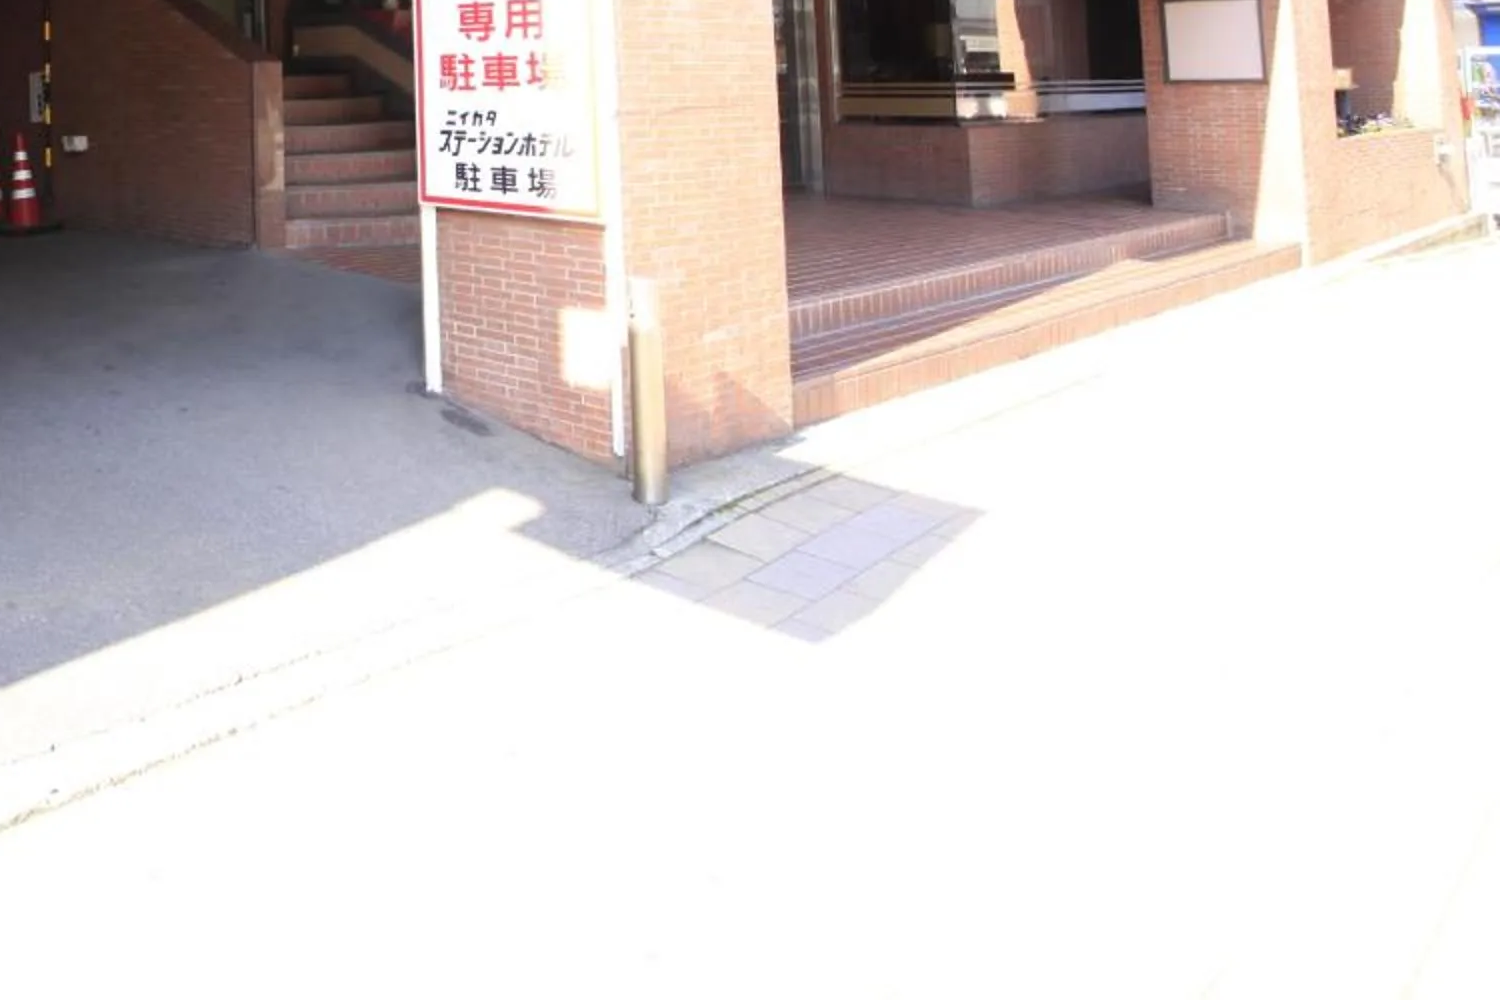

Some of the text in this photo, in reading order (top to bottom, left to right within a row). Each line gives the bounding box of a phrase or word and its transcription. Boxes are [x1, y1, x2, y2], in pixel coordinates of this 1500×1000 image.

[438, 129, 575, 157] ステーションホテル
[454, 162, 558, 199] 駐車場
